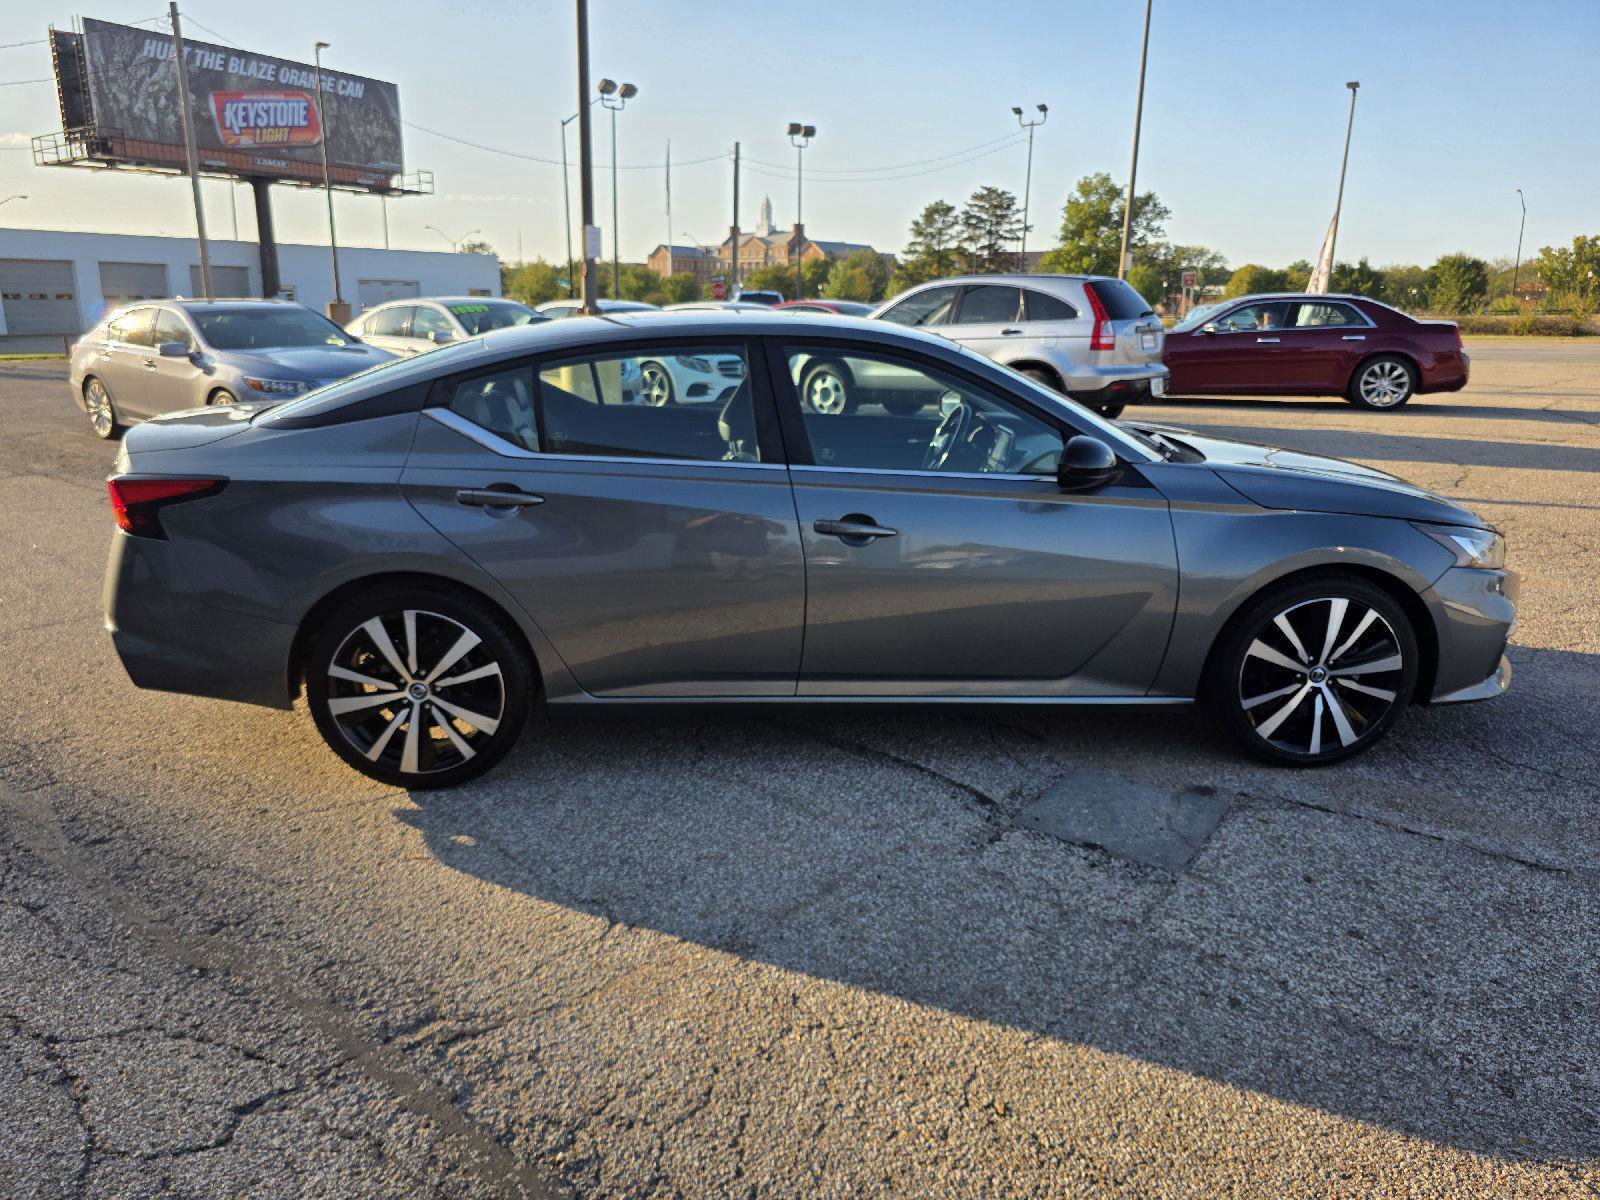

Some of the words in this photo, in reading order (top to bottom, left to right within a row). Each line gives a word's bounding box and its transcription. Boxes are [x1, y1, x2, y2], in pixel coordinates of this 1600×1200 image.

[194, 48, 226, 72] THE
[228, 55, 277, 81] BLAZE
[279, 67, 336, 93] ORANGE
[338, 79, 365, 98] CAN
[224, 101, 309, 135] KEYSTONE
[255, 127, 290, 144] LIGHT
